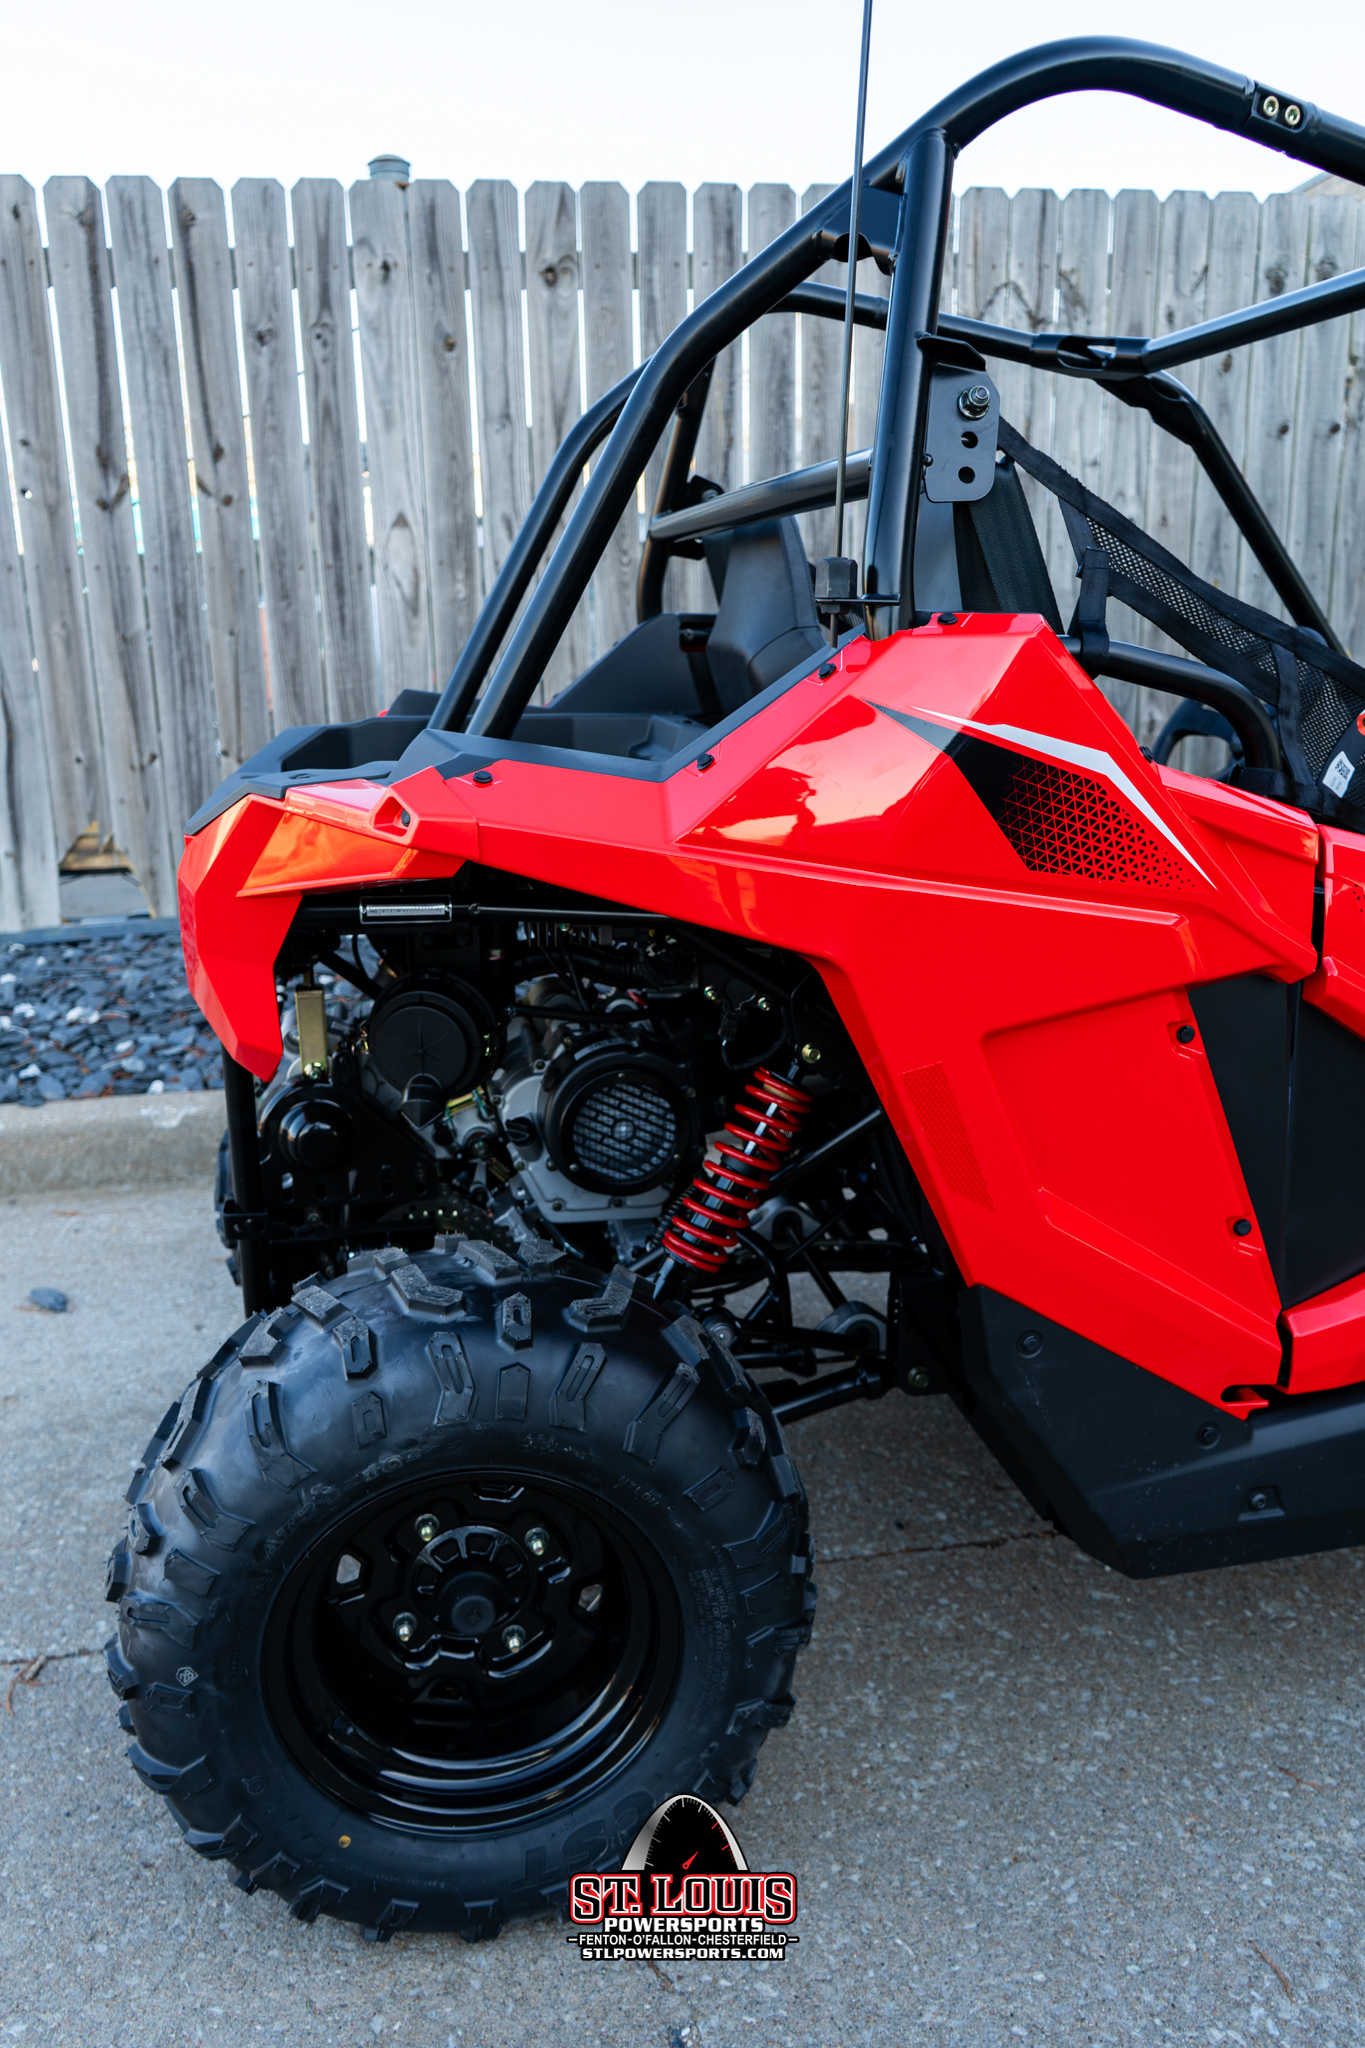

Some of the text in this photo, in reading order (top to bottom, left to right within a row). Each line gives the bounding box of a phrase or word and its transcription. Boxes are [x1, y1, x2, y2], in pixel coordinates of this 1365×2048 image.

[617, 1475, 660, 1507] NYLON
[712, 1584, 731, 1619] VEHICLE
[510, 1789, 656, 1893] CST
